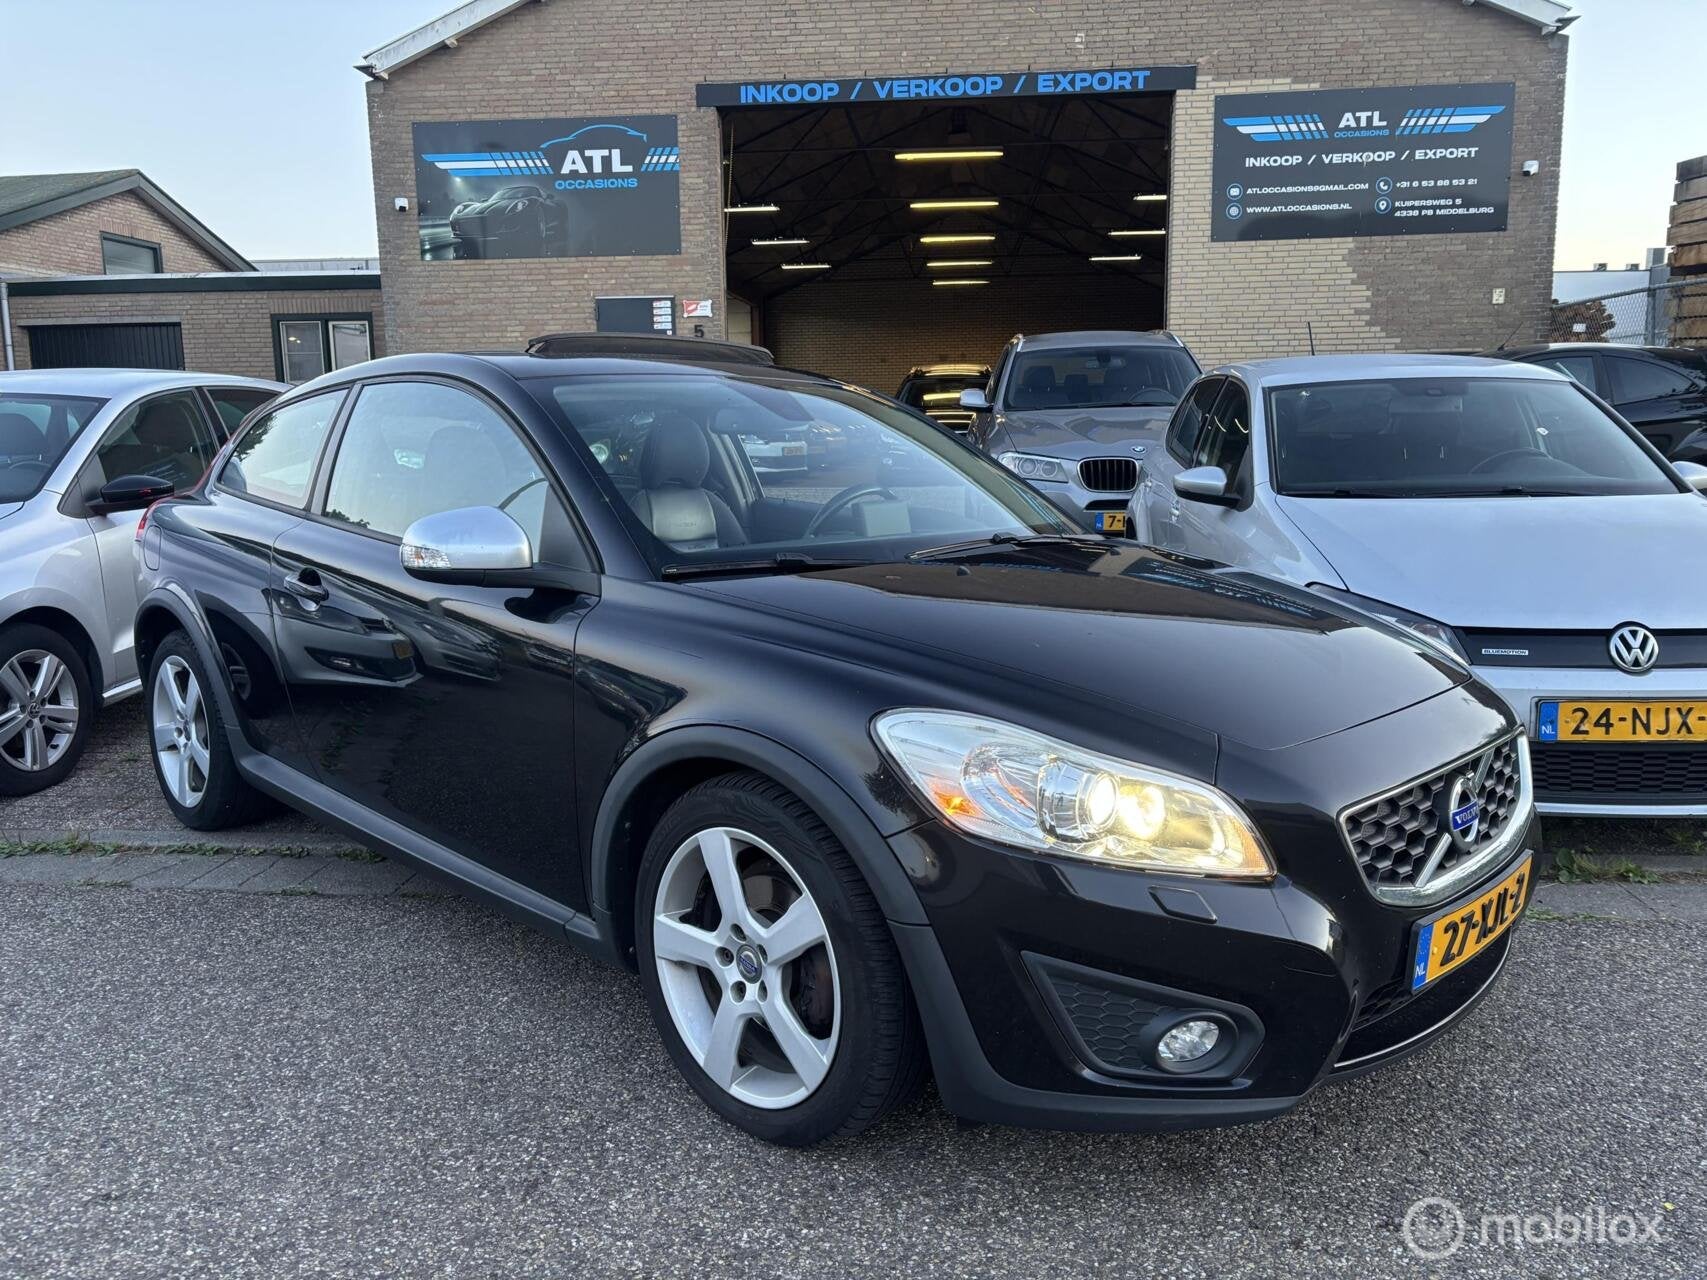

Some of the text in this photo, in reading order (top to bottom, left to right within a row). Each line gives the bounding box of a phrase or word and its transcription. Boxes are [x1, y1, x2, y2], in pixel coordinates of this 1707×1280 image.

[739, 71, 1151, 104] INKOOP / VERKOOP / EXPORT
[1338, 111, 1388, 129] ATL
[1334, 129, 1390, 138] OCCASIONS
[560, 148, 633, 174] ATL
[1245, 147, 1479, 167] INKOOP / VERKOOP / EXPORT
[554, 178, 638, 190] OCCASIONS
[1246, 203, 1353, 213] WWW.ATLOCCASIONS.NL
[1395, 199, 1453, 207] KUIPERSWEG
[1436, 207, 1494, 215] MIDDELBURG
[694, 324, 704, 338] 5
[1541, 725, 1556, 734] NL
[1414, 962, 1426, 977] NL
